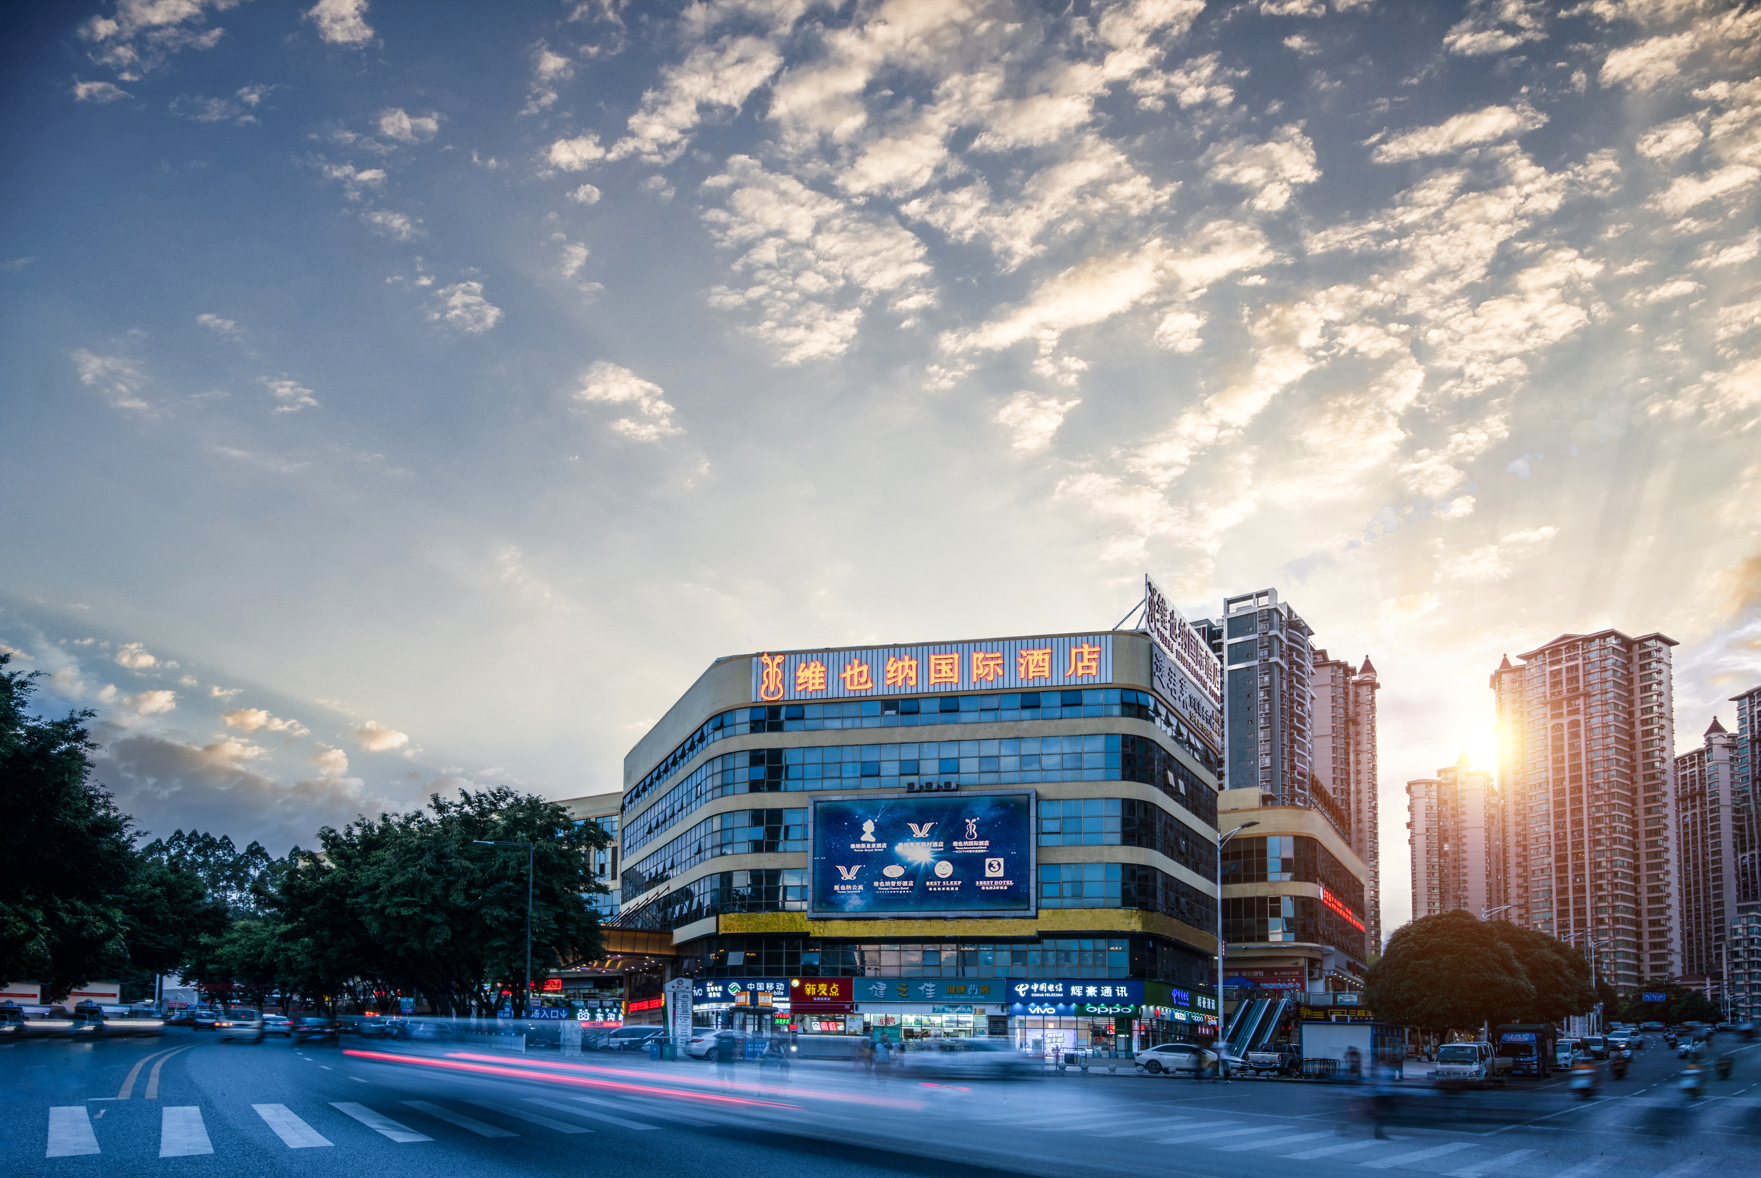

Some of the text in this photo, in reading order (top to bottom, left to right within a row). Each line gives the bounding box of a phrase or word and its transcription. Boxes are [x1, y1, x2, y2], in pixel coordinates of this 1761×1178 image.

[1156, 593, 1220, 691] 维也纳国际酒店
[796, 643, 1101, 692] 维也纳国际酒店
[693, 986, 702, 997] ivo
[747, 982, 784, 991] 中国移动
[868, 981, 990, 999] 健之佳 健康药房
[1031, 983, 1128, 998] 中国电信 辉豪通讯
[1028, 1006, 1056, 1014] vivo
[1086, 1006, 1132, 1015] oppo
